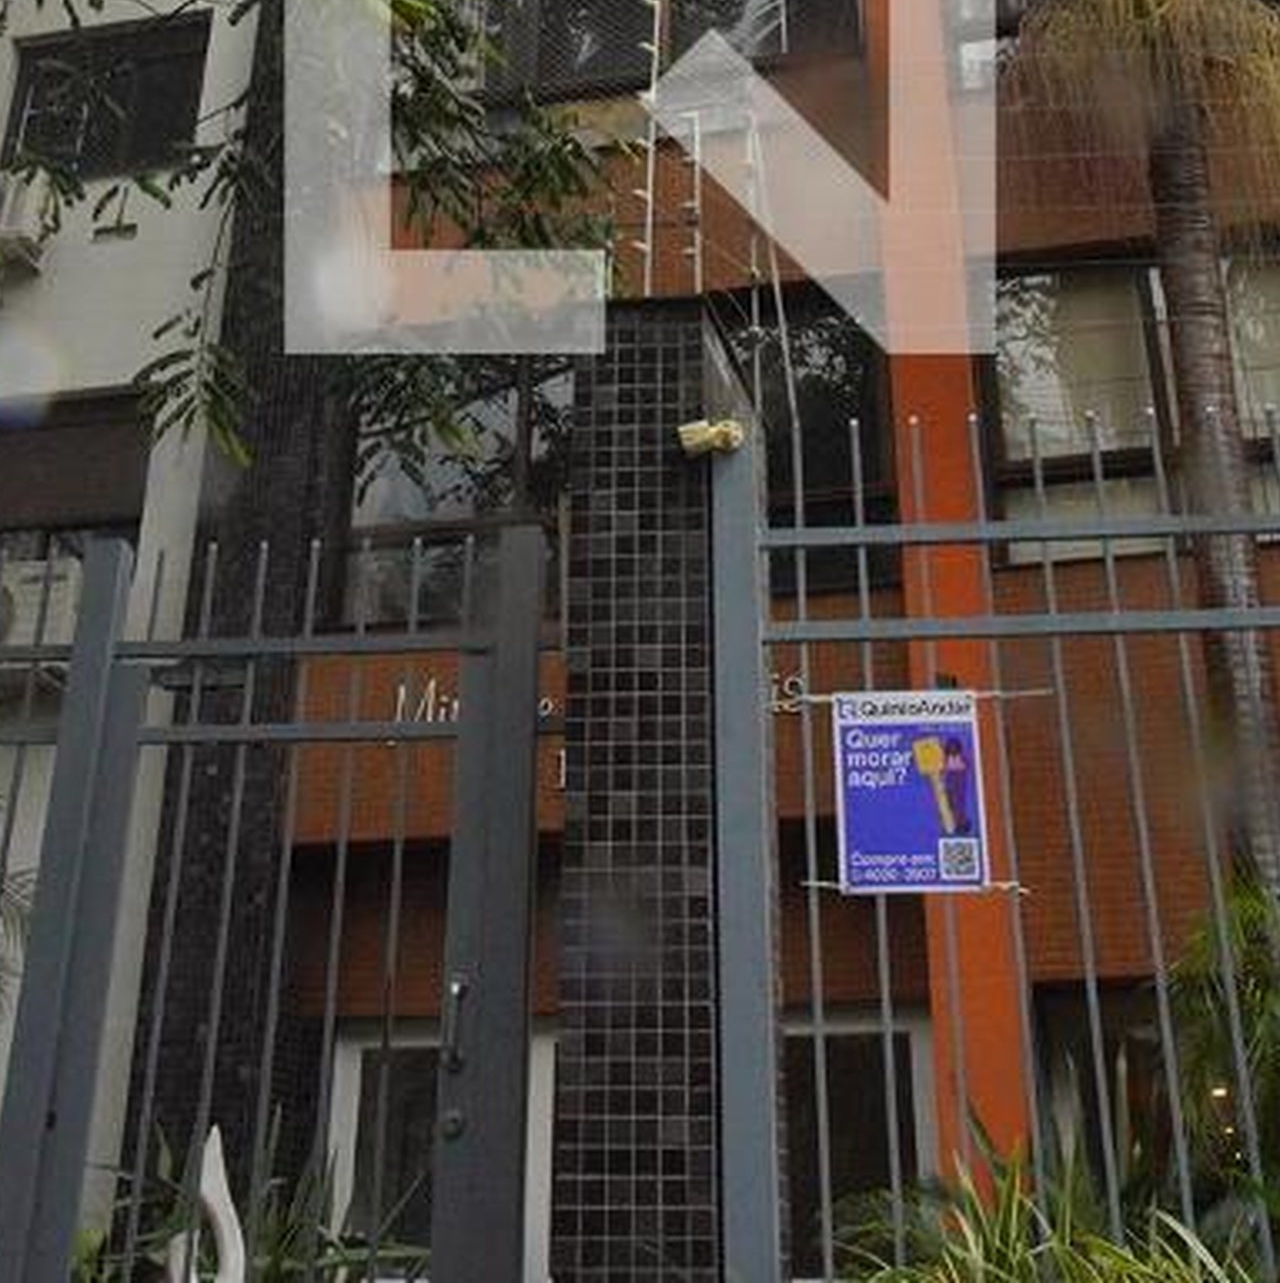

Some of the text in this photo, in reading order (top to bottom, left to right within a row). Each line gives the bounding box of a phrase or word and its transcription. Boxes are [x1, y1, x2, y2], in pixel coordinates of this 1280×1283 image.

[846, 729, 899, 748] Quer
[847, 751, 912, 766] morar
[847, 769, 908, 789] aqui?
